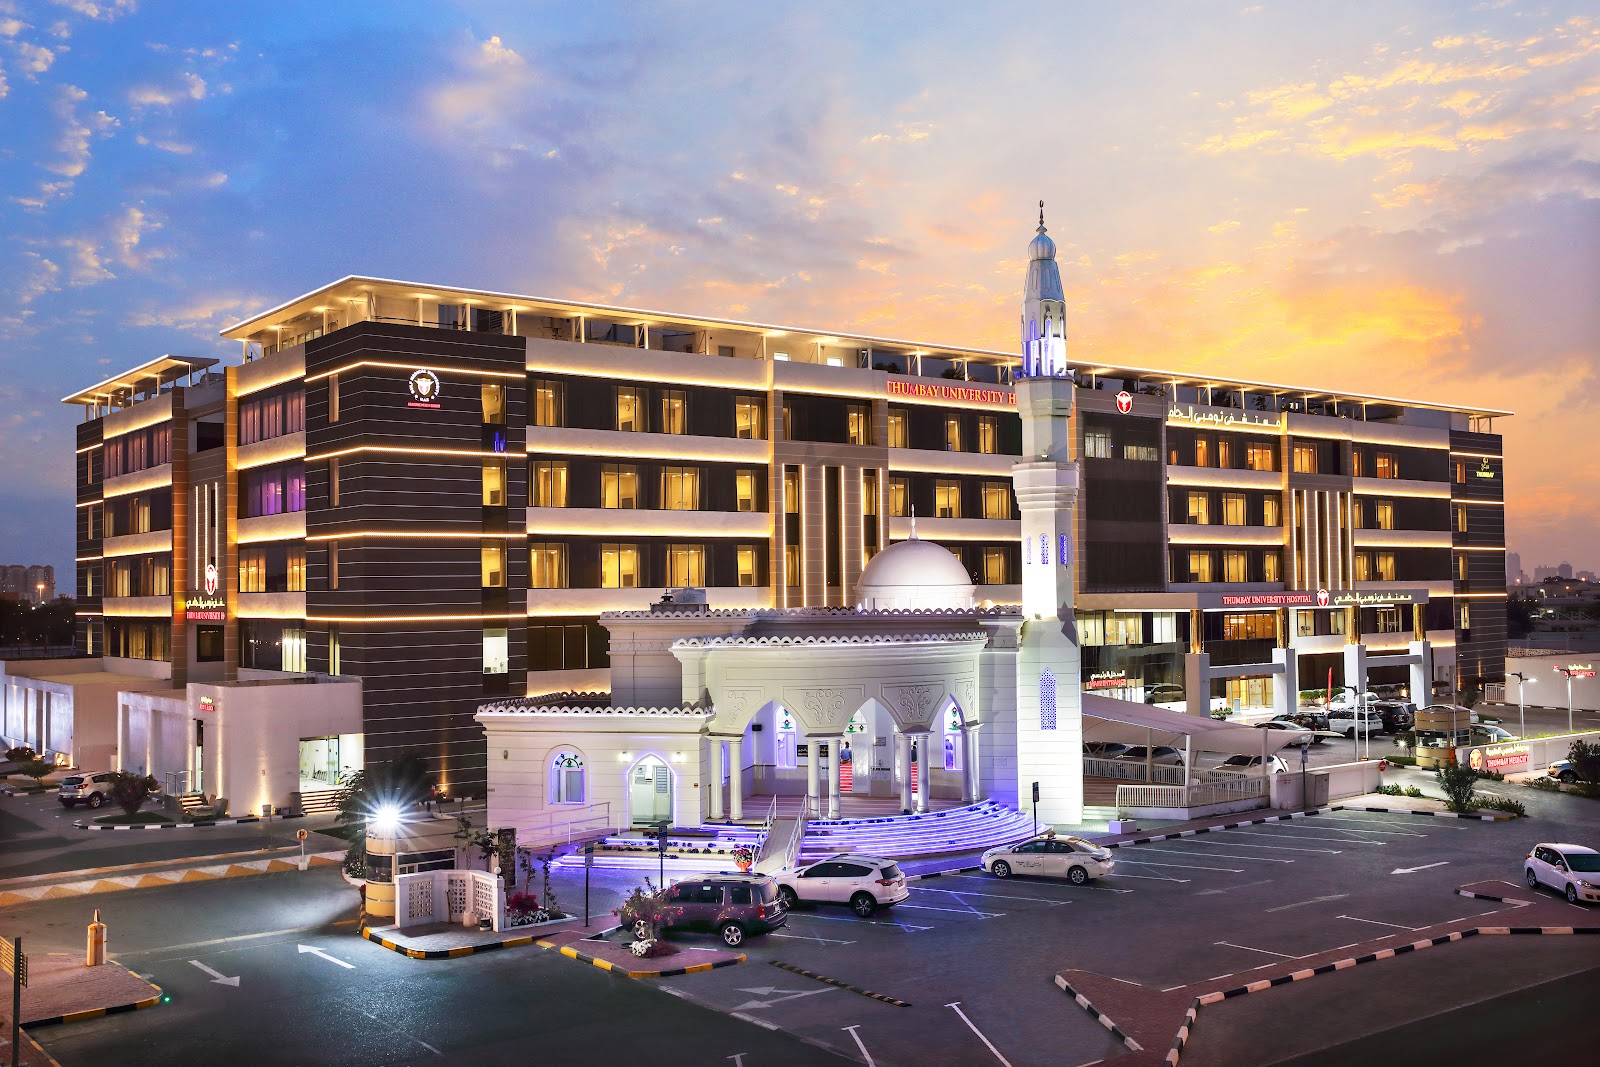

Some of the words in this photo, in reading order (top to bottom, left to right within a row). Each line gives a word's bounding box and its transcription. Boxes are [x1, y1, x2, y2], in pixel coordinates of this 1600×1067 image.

[886, 381, 940, 398] THUMBAY
[941, 386, 1005, 404] UNIVERSITY
[1223, 596, 1251, 605] THUMBAY
[1251, 595, 1286, 604] UNIVERSITY
[1286, 595, 1312, 603] HOSPITAL
[1487, 757, 1507, 767] THUMBAY
